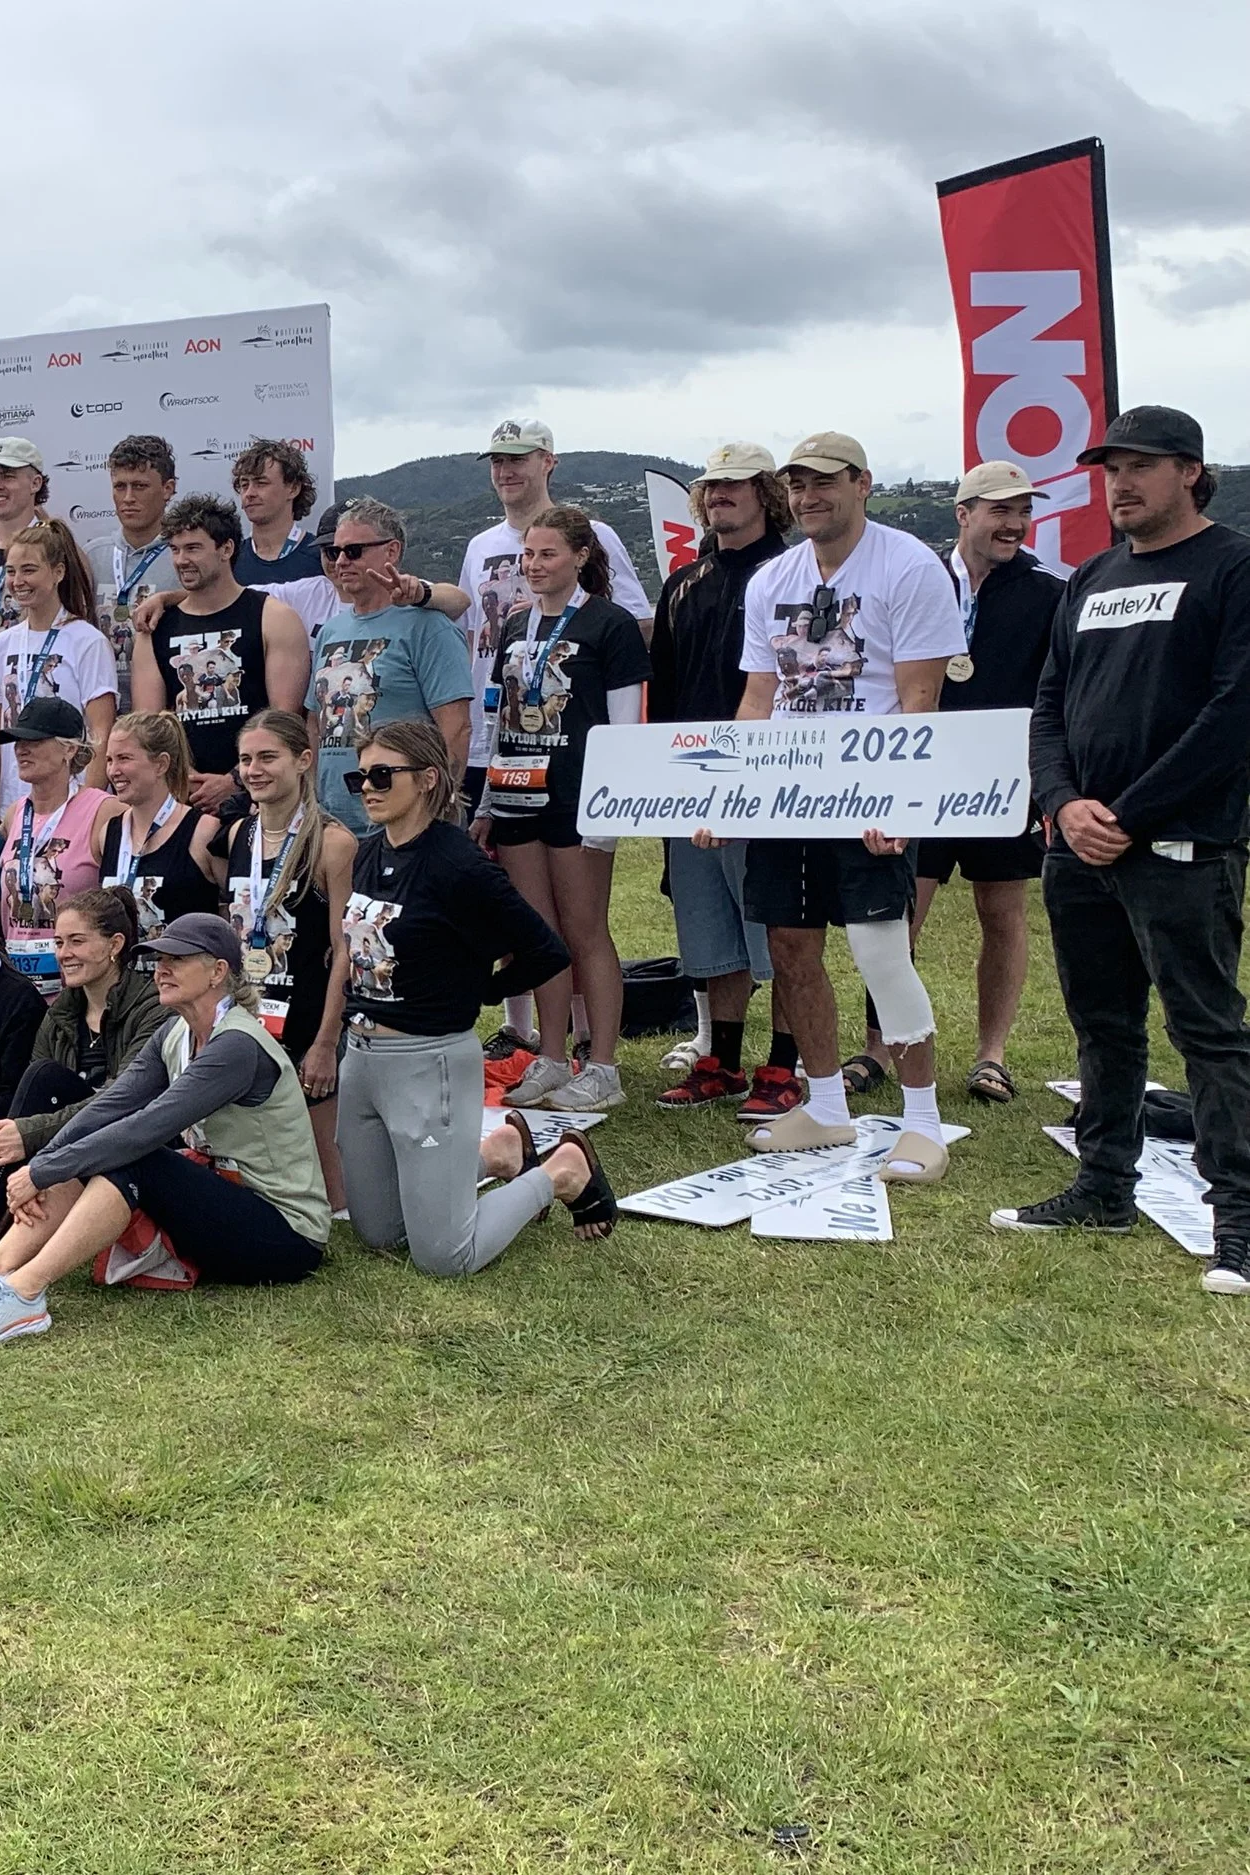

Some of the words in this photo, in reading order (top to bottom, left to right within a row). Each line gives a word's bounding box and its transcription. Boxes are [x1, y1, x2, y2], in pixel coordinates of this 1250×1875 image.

[184, 338, 221, 355] AON
[47, 352, 81, 368] AON
[86, 402, 123, 413] topo
[166, 395, 220, 407] WRIGHTSOCK
[76, 510, 116, 520] WRIGHTSO
[1088, 597, 1147, 618] Hurley
[822, 698, 866, 712] KITE
[177, 708, 219, 722] TAYLOR
[221, 706, 249, 717] KITE
[500, 731, 537, 745] TAYLOR
[671, 733, 707, 748] AON
[747, 729, 826, 746] WHITIANGA
[840, 725, 933, 763] 2022
[745, 747, 823, 771] marathon
[501, 771, 531, 786] 1159
[586, 785, 717, 827] Conquered
[720, 783, 759, 819] the
[770, 782, 894, 820] Marathon
[933, 777, 1020, 826] yeah!
[264, 974, 294, 987] KITE
[823, 1200, 879, 1233] We
